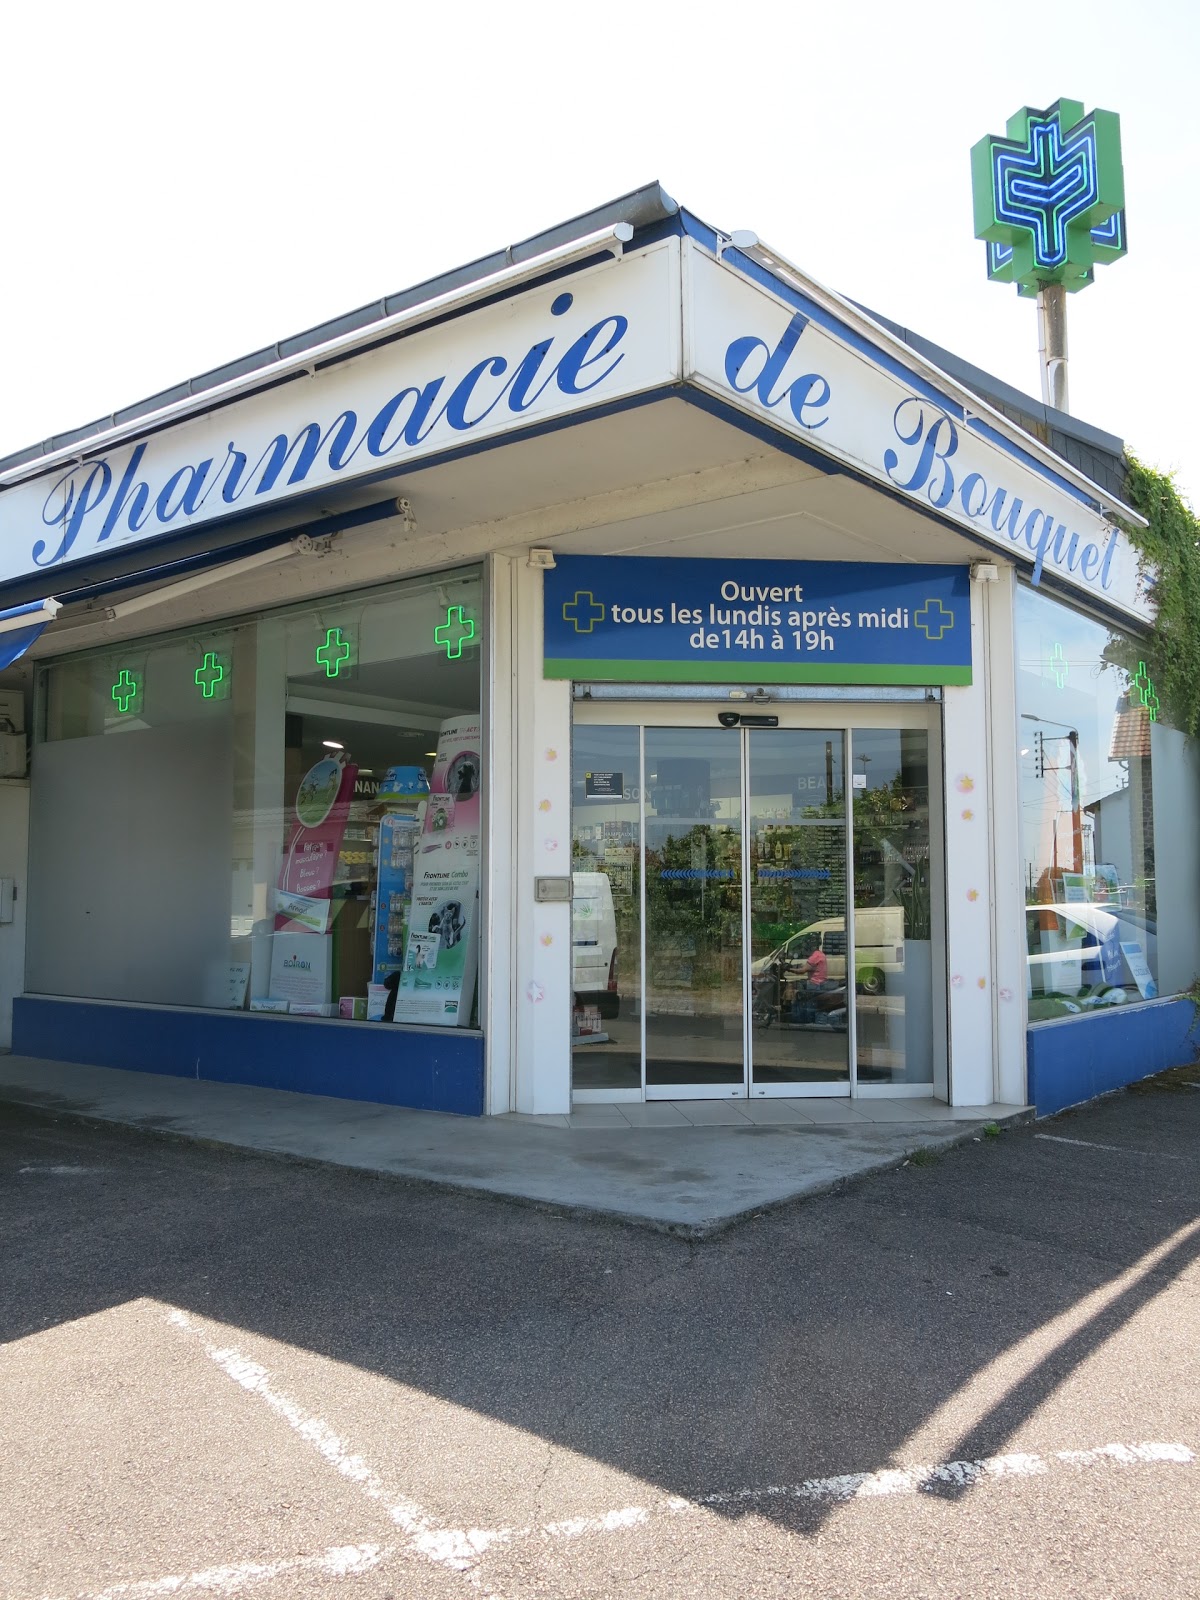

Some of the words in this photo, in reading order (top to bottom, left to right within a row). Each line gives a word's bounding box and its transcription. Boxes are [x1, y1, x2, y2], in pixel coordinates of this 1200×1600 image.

[32, 292, 628, 567] Pharmacie
[725, 311, 831, 429] de
[884, 397, 1120, 590] Bouquet
[721, 580, 804, 602] Ouvert
[611, 605, 664, 625] tous
[671, 603, 703, 625] les
[709, 604, 782, 627] lundis
[787, 606, 852, 632] après
[858, 607, 910, 629] midi
[689, 626, 765, 651] de14h
[771, 628, 785, 650] à
[791, 629, 836, 651] 19h
[424, 871, 451, 879] FRONTLINE
